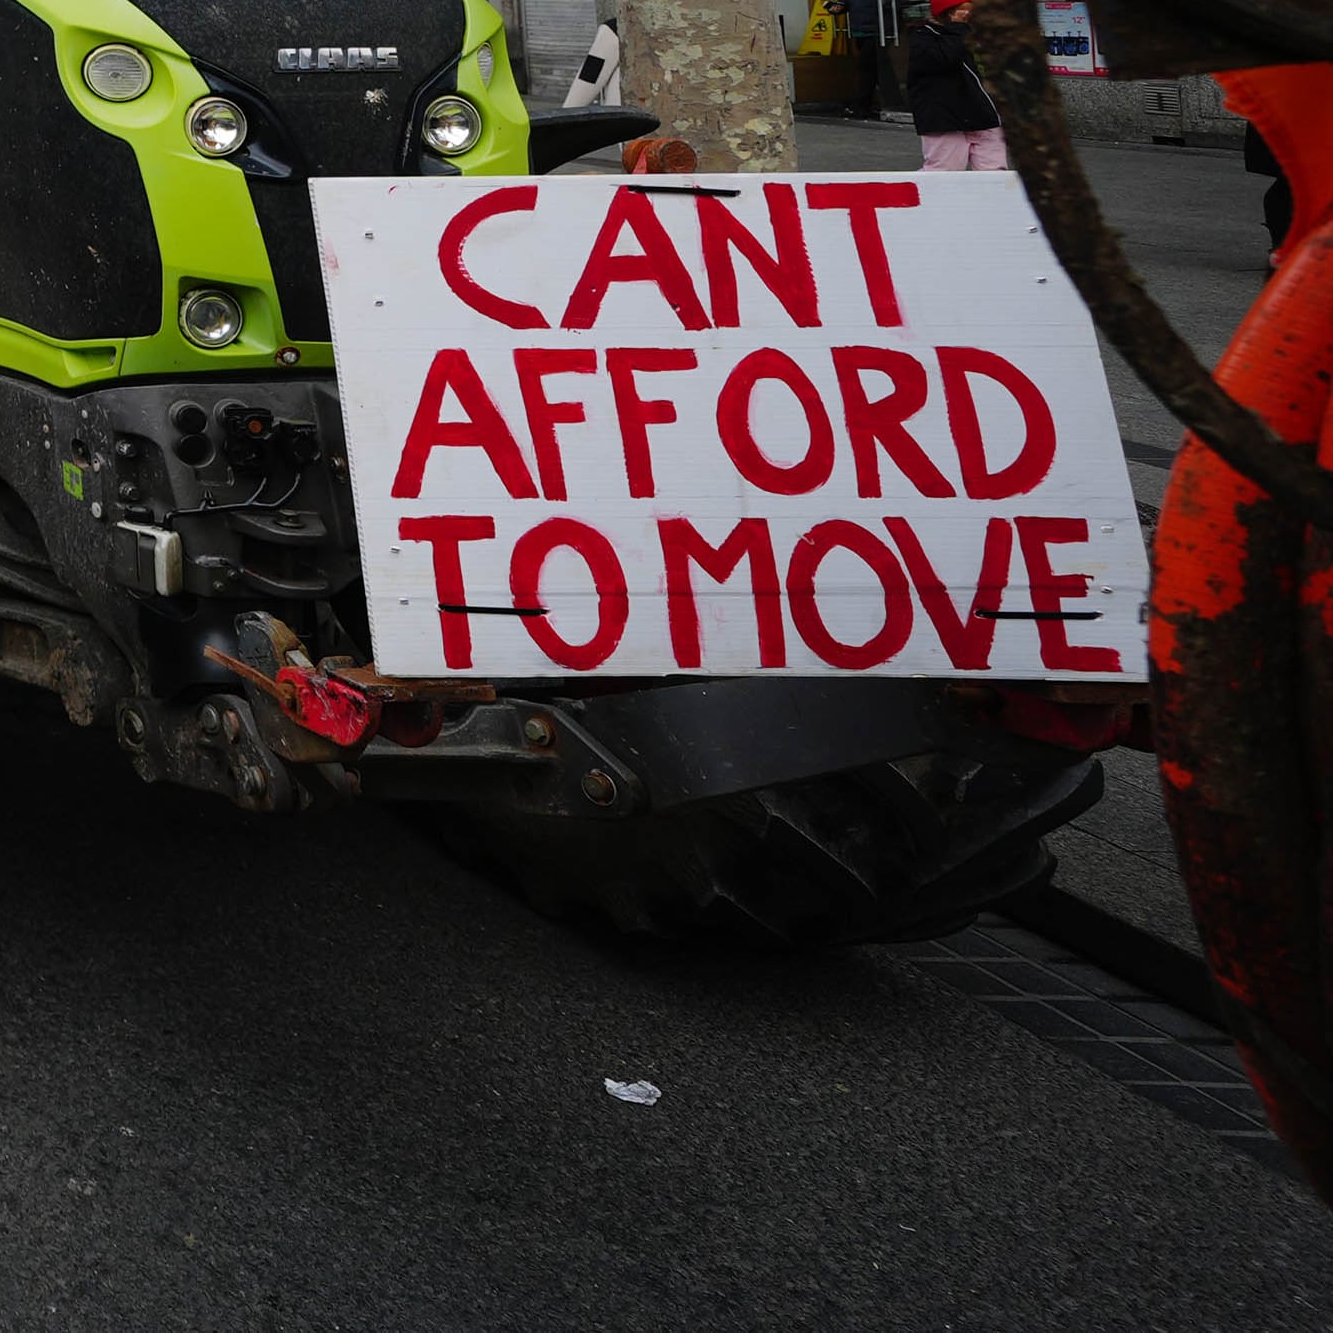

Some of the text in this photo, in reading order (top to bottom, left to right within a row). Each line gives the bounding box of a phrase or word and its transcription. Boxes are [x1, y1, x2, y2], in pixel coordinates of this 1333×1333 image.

[277, 47, 399, 70] CLAAS
[437, 181, 921, 331] CANT
[391, 344, 1057, 502] AFFORD
[398, 515, 1124, 674] TO MOVE
